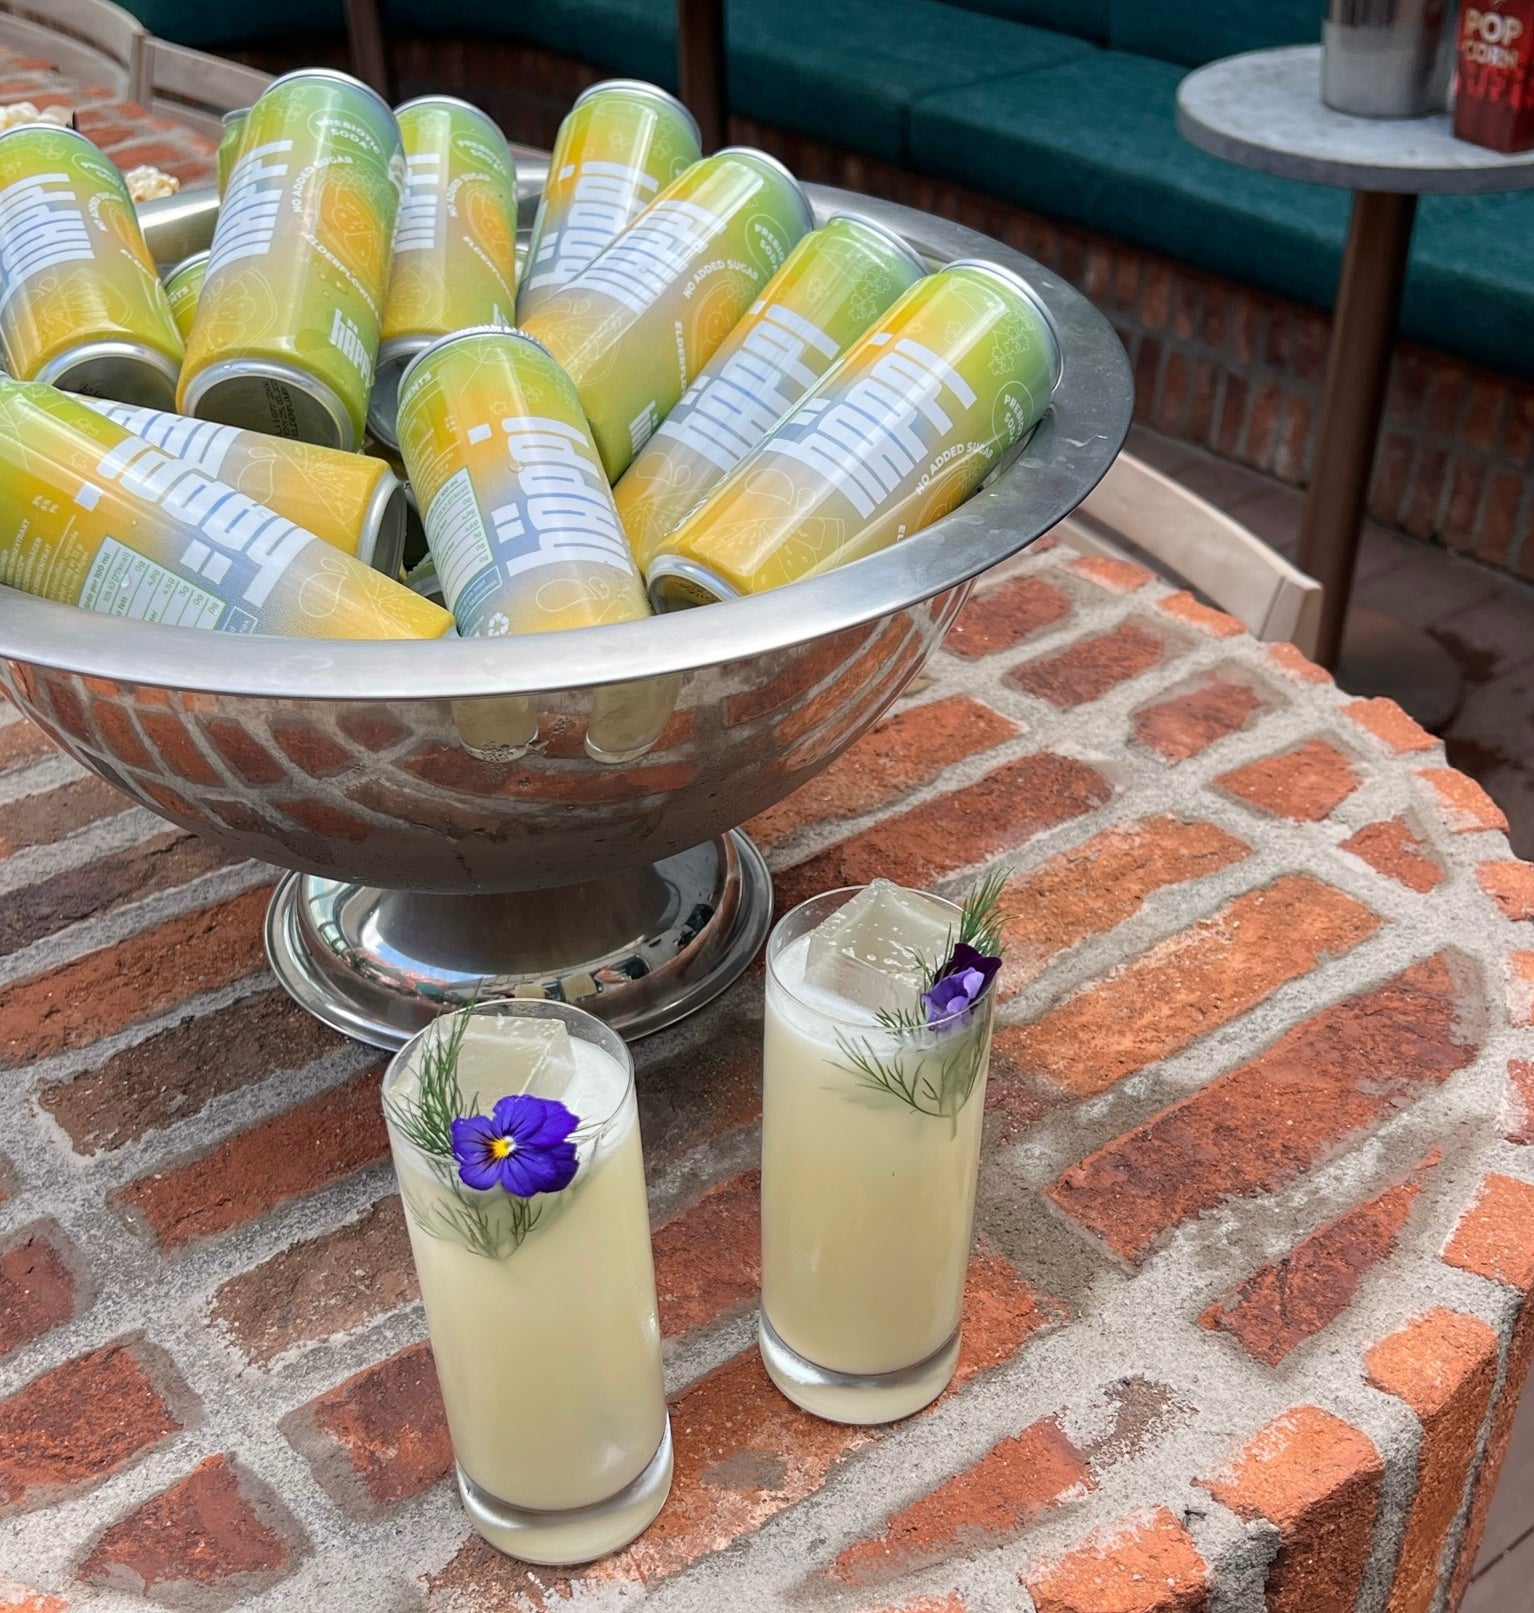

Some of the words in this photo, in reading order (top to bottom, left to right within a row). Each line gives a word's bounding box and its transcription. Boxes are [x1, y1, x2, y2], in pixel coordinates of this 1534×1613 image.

[1465, 8, 1523, 46] POP
[1462, 38, 1520, 68] CORN
[292, 166, 314, 197] ADDED
[292, 198, 303, 213] NO
[755, 223, 785, 261] PREBIO
[682, 281, 696, 299] NO
[693, 260, 726, 284] ADDED
[727, 259, 759, 281] SUGAR
[674, 320, 687, 391] ELDERFLO
[914, 472, 931, 496] NO
[929, 443, 965, 477] ADDED
[966, 441, 995, 460] SUGAR
[94, 565, 104, 580] 100
[103, 552, 111, 564] ml
[118, 596, 128, 610] fett
